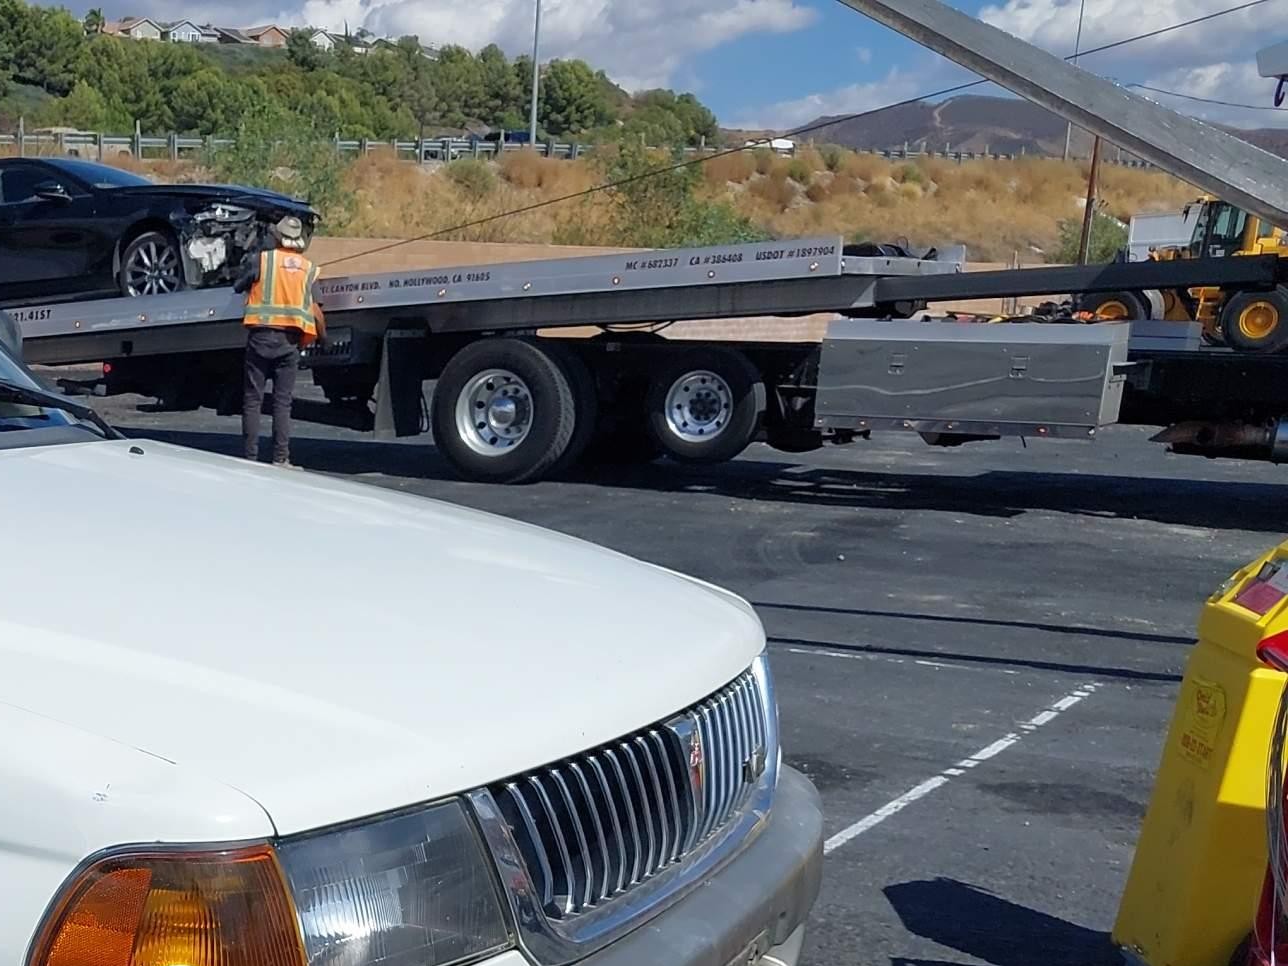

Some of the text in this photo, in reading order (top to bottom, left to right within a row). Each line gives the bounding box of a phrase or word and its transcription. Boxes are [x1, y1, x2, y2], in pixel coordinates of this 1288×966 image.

[625, 261, 638, 271] MC
[689, 256, 700, 266] CA
[755, 249, 785, 261] USDOT
[787, 245, 835, 258] #1897904
[330, 283, 359, 294] CANYON
[361, 281, 381, 291] BLVD.
[452, 273, 462, 283] CA
[466, 271, 491, 282] 91605
